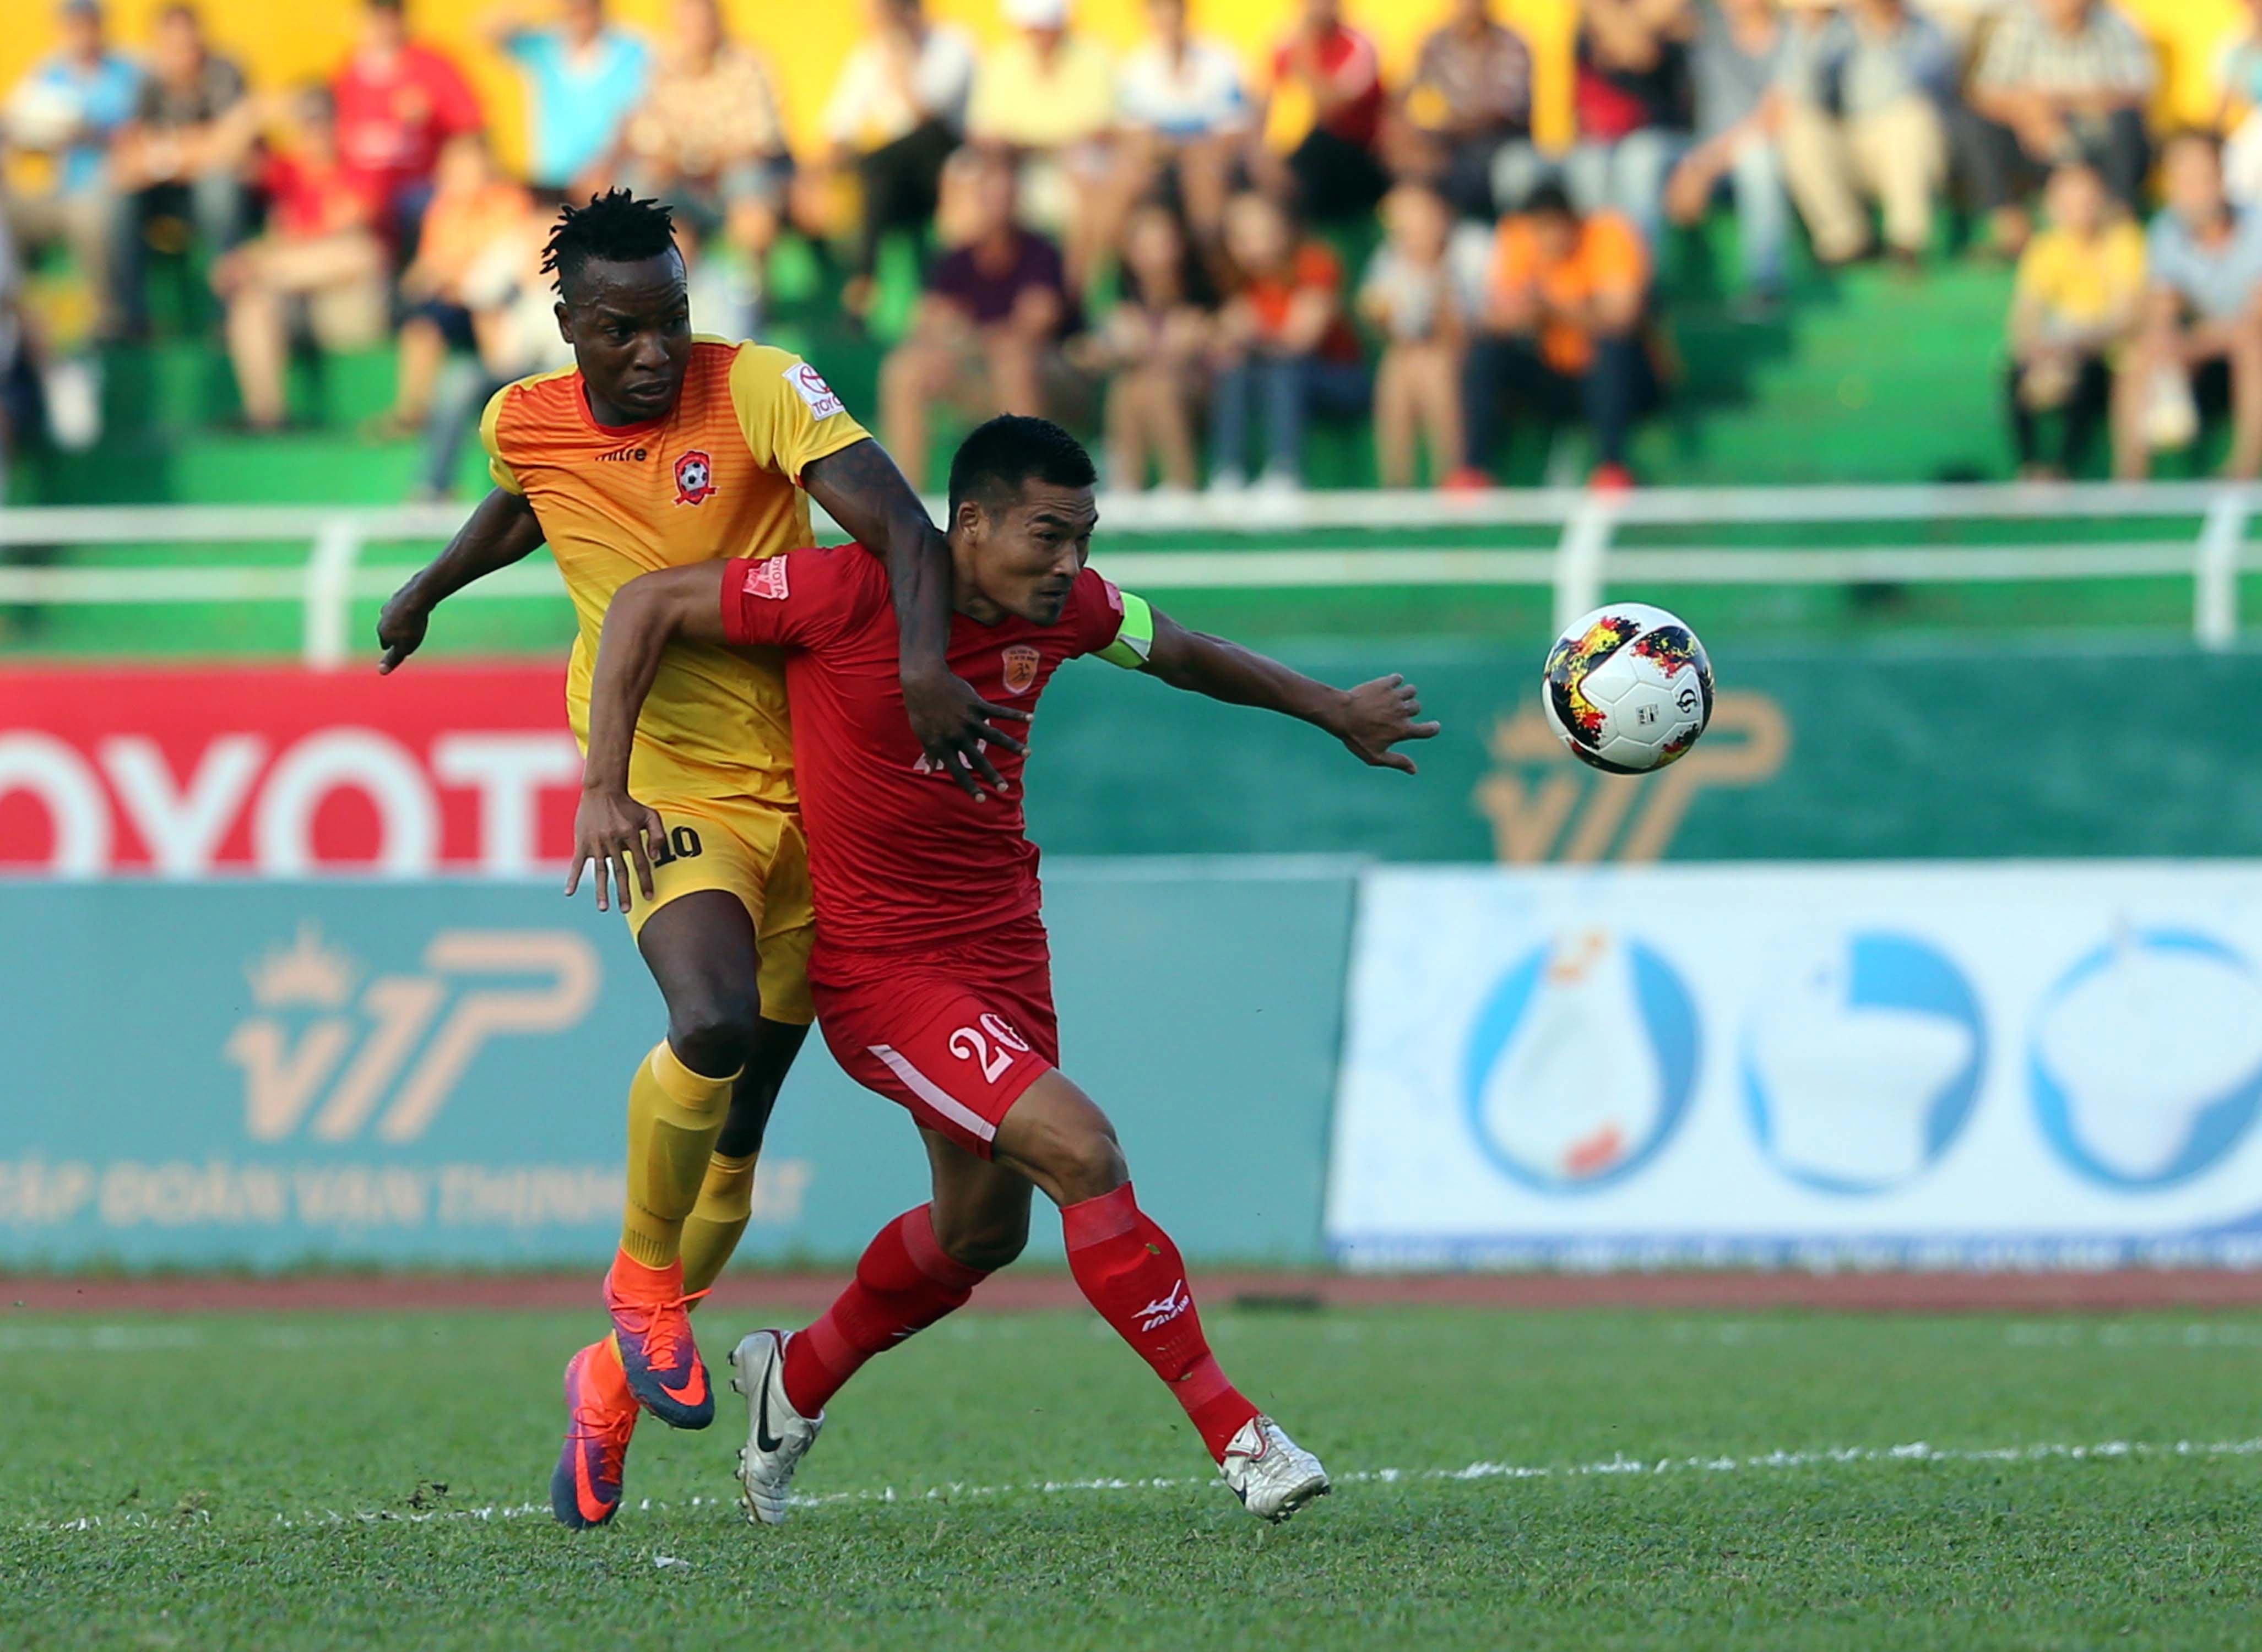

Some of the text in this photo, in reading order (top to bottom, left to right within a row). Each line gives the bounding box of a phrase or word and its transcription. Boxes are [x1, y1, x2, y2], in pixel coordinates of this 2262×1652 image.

[0, 728, 590, 877] OYOT
[654, 825, 702, 868] 10
[948, 1012, 1029, 1084] 20
